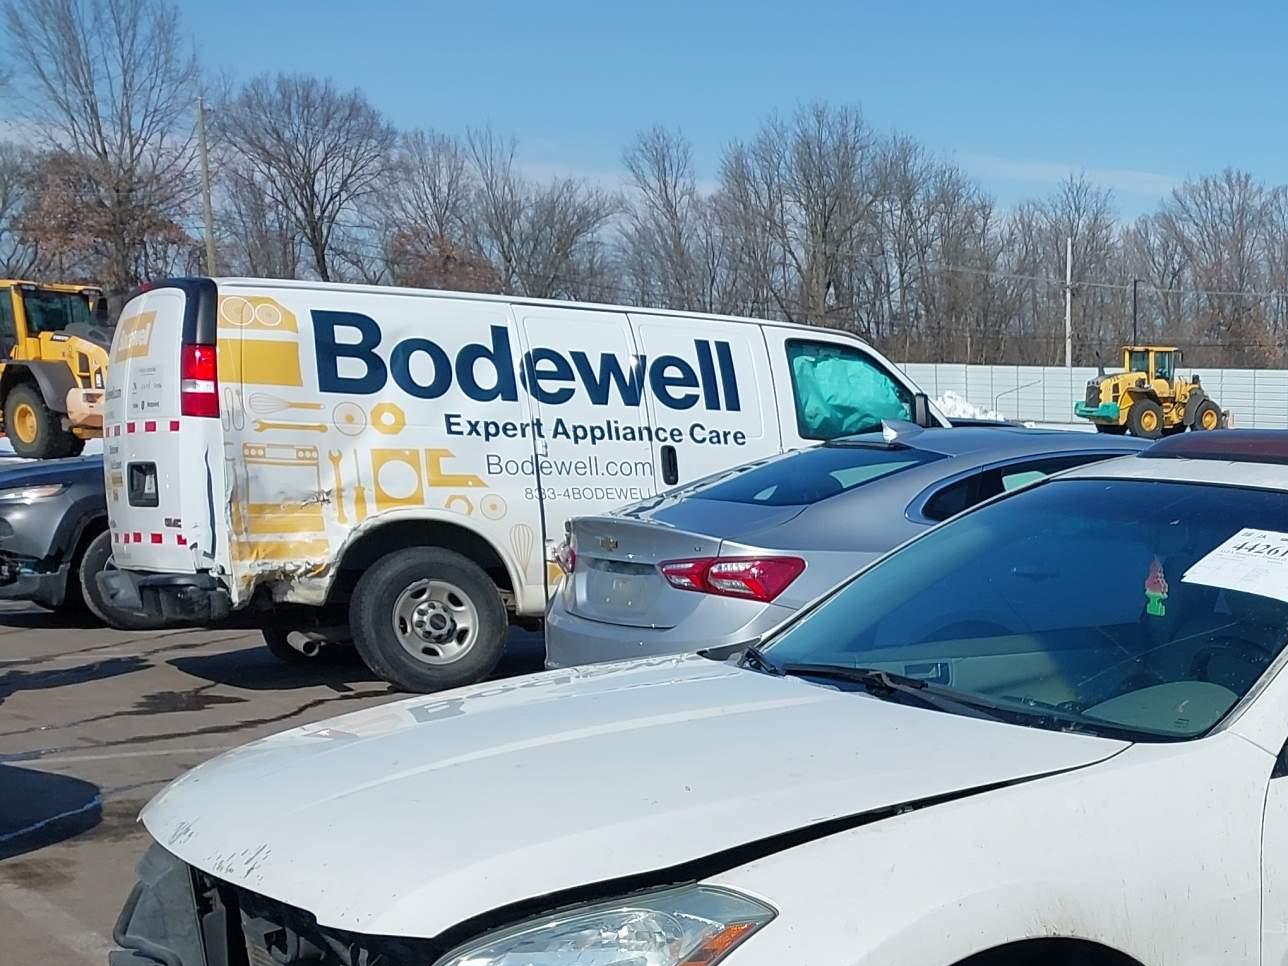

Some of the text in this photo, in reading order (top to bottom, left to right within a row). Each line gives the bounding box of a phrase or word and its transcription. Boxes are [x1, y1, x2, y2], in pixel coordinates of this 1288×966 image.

[310, 309, 741, 412] Bodewell
[444, 413, 746, 446] Expert Appliance Care
[486, 453, 653, 477] Bodewell.com
